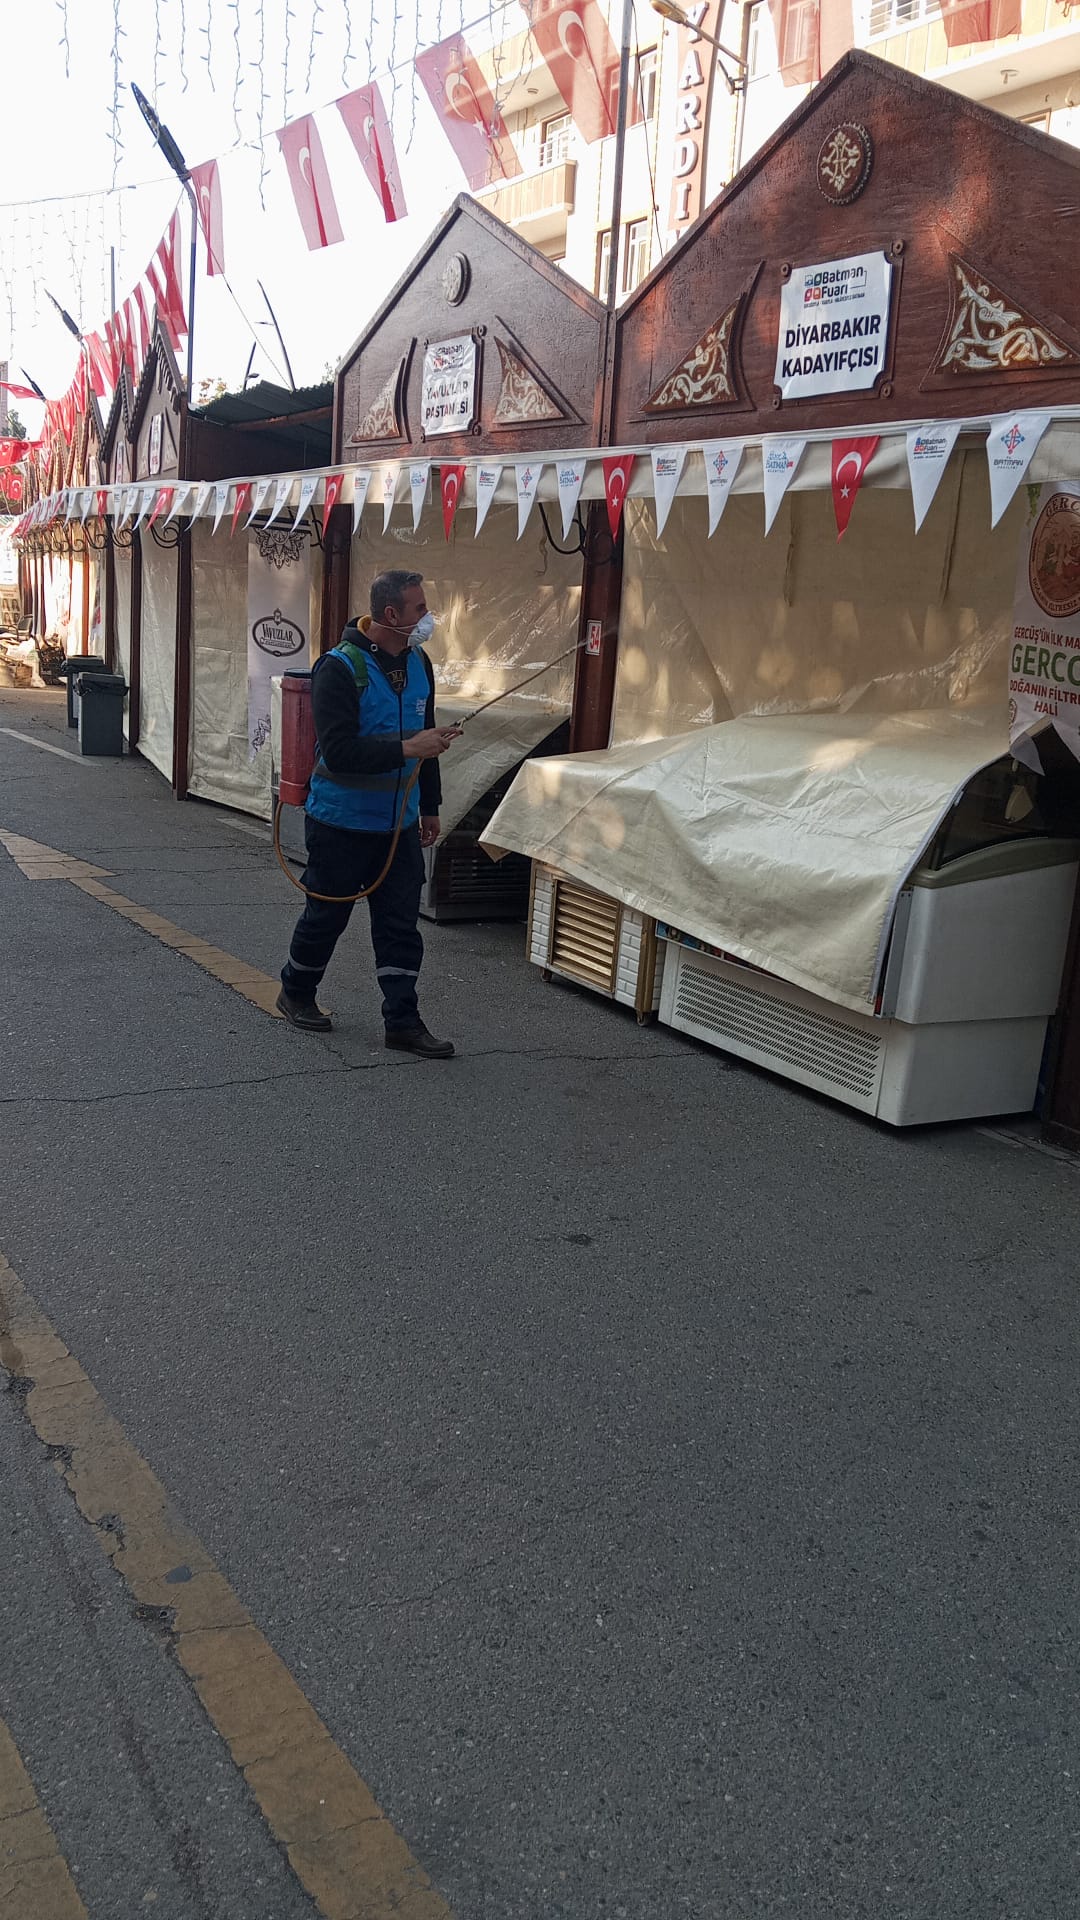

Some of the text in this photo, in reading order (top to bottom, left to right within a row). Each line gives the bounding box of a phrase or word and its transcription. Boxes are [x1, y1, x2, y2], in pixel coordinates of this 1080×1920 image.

[823, 266, 864, 285] Batman
[785, 314, 881, 349] DİYARBAKIR
[781, 345, 879, 378] KADAYIFÇISI
[425, 397, 469, 420] PASTANSİ
[1033, 701, 1058, 717] HALİ
